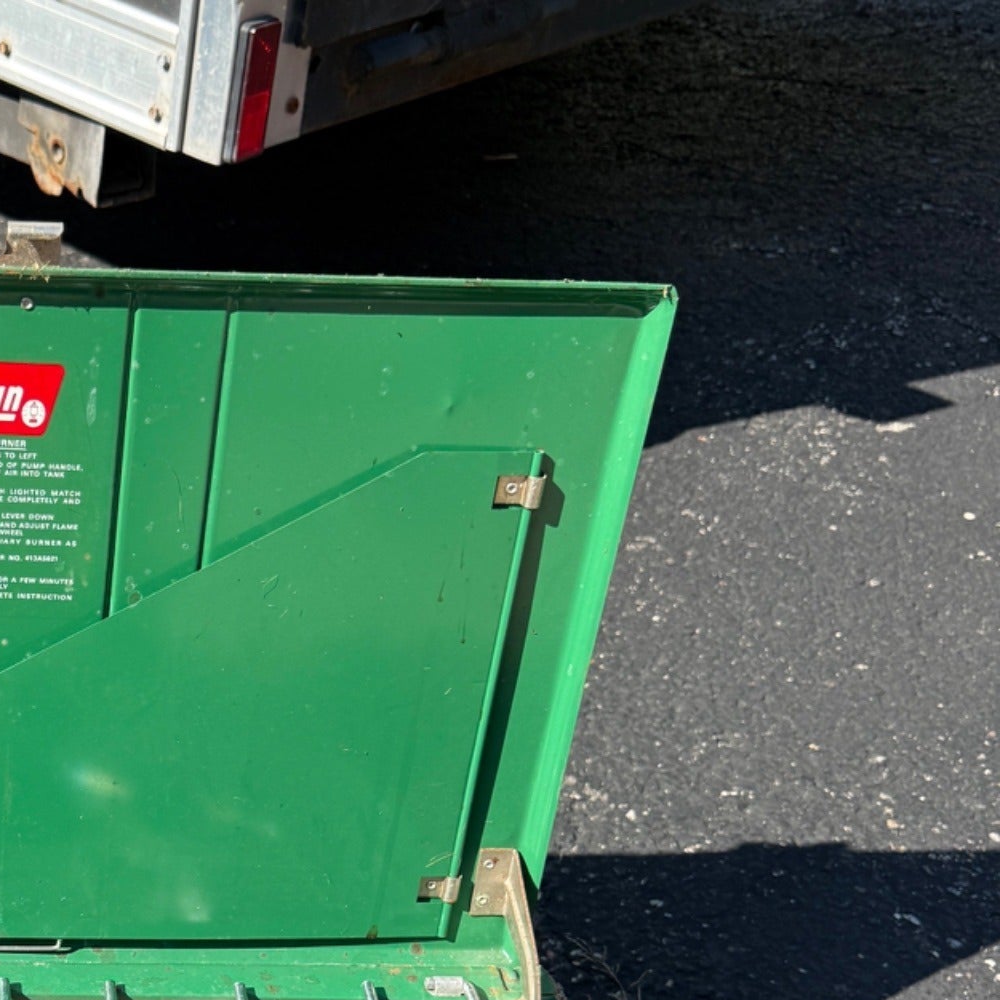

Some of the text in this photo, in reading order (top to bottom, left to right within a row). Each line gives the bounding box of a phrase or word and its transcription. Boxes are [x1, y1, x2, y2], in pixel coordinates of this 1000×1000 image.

[50, 489, 81, 497] MATCH
[8, 495, 57, 504] COMPLETELY
[40, 577, 73, 585] MINUTES
[17, 593, 72, 601] INSTRUCTION
